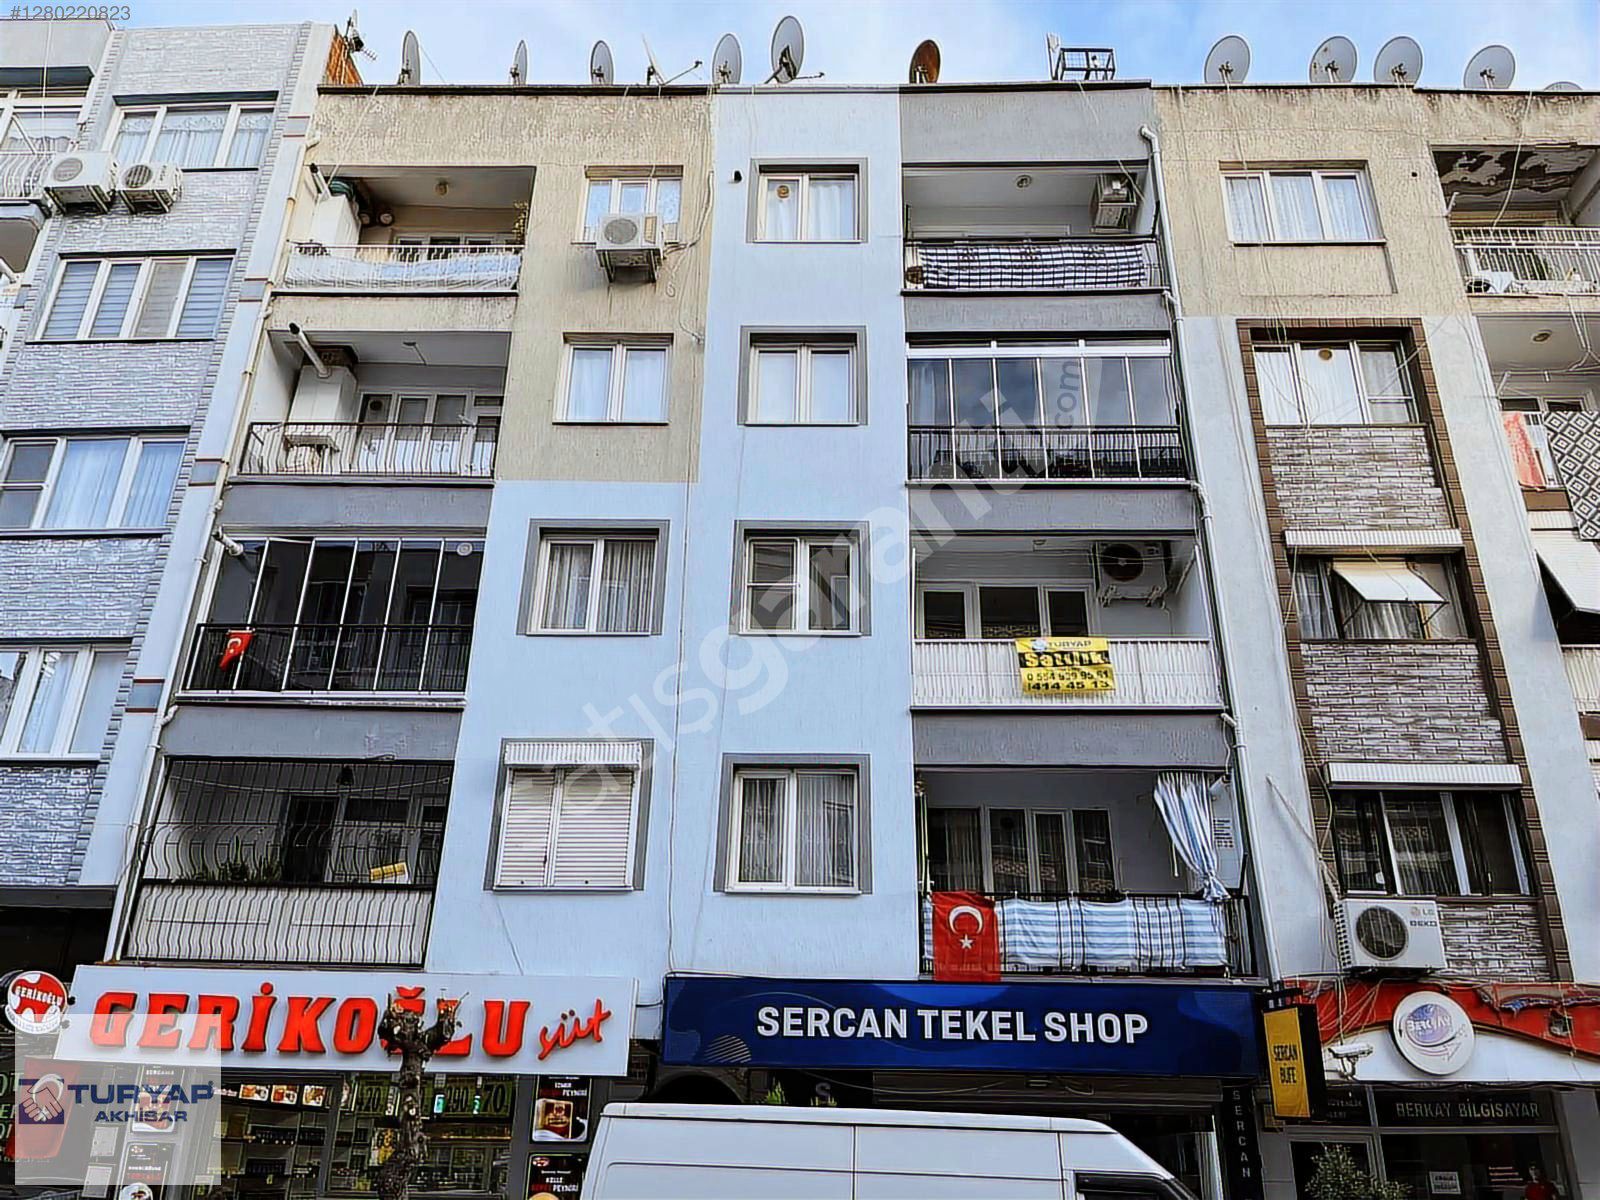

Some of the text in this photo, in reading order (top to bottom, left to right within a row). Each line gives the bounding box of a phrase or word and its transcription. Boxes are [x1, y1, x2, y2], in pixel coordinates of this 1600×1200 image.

[756, 1005, 1149, 1045] SERCAN TEKEL SHOP
[1273, 1043, 1299, 1062] SERCAN
[1396, 1098, 1541, 1118] BERKAY BİLGİSAYAR
[1232, 1090, 1251, 1178] SERCAN
